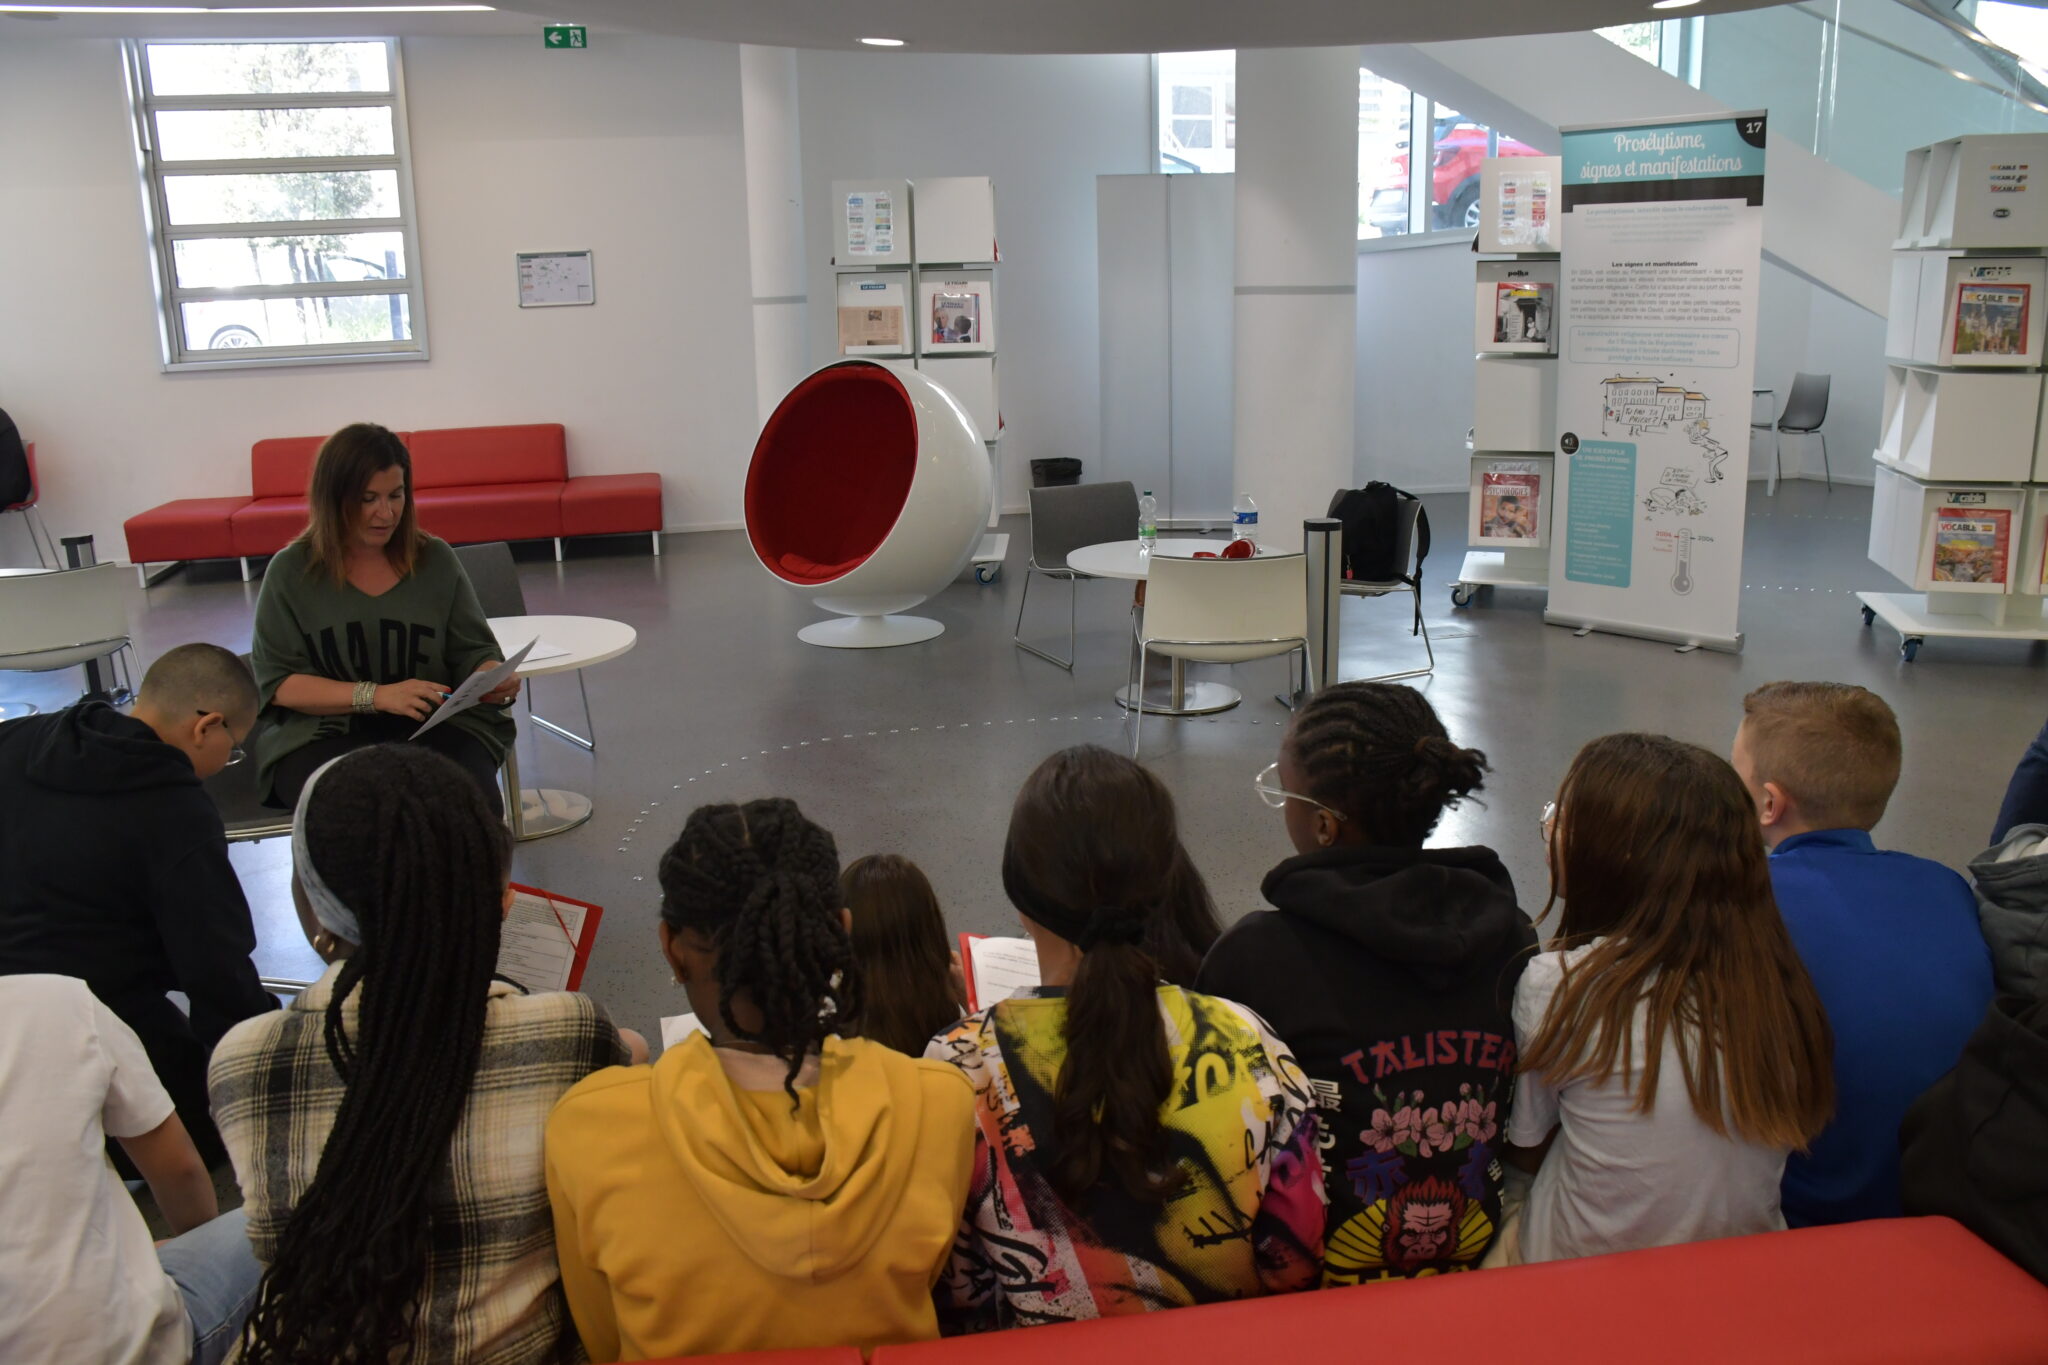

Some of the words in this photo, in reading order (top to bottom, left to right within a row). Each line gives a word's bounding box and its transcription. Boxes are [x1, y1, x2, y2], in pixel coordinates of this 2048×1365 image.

[1746, 122, 1762, 134] 17
[1614, 131, 1705, 155] Prosélytisme,
[1580, 161, 1622, 183] signes
[1625, 160, 1639, 176] et
[1640, 154, 1743, 179] manifestations
